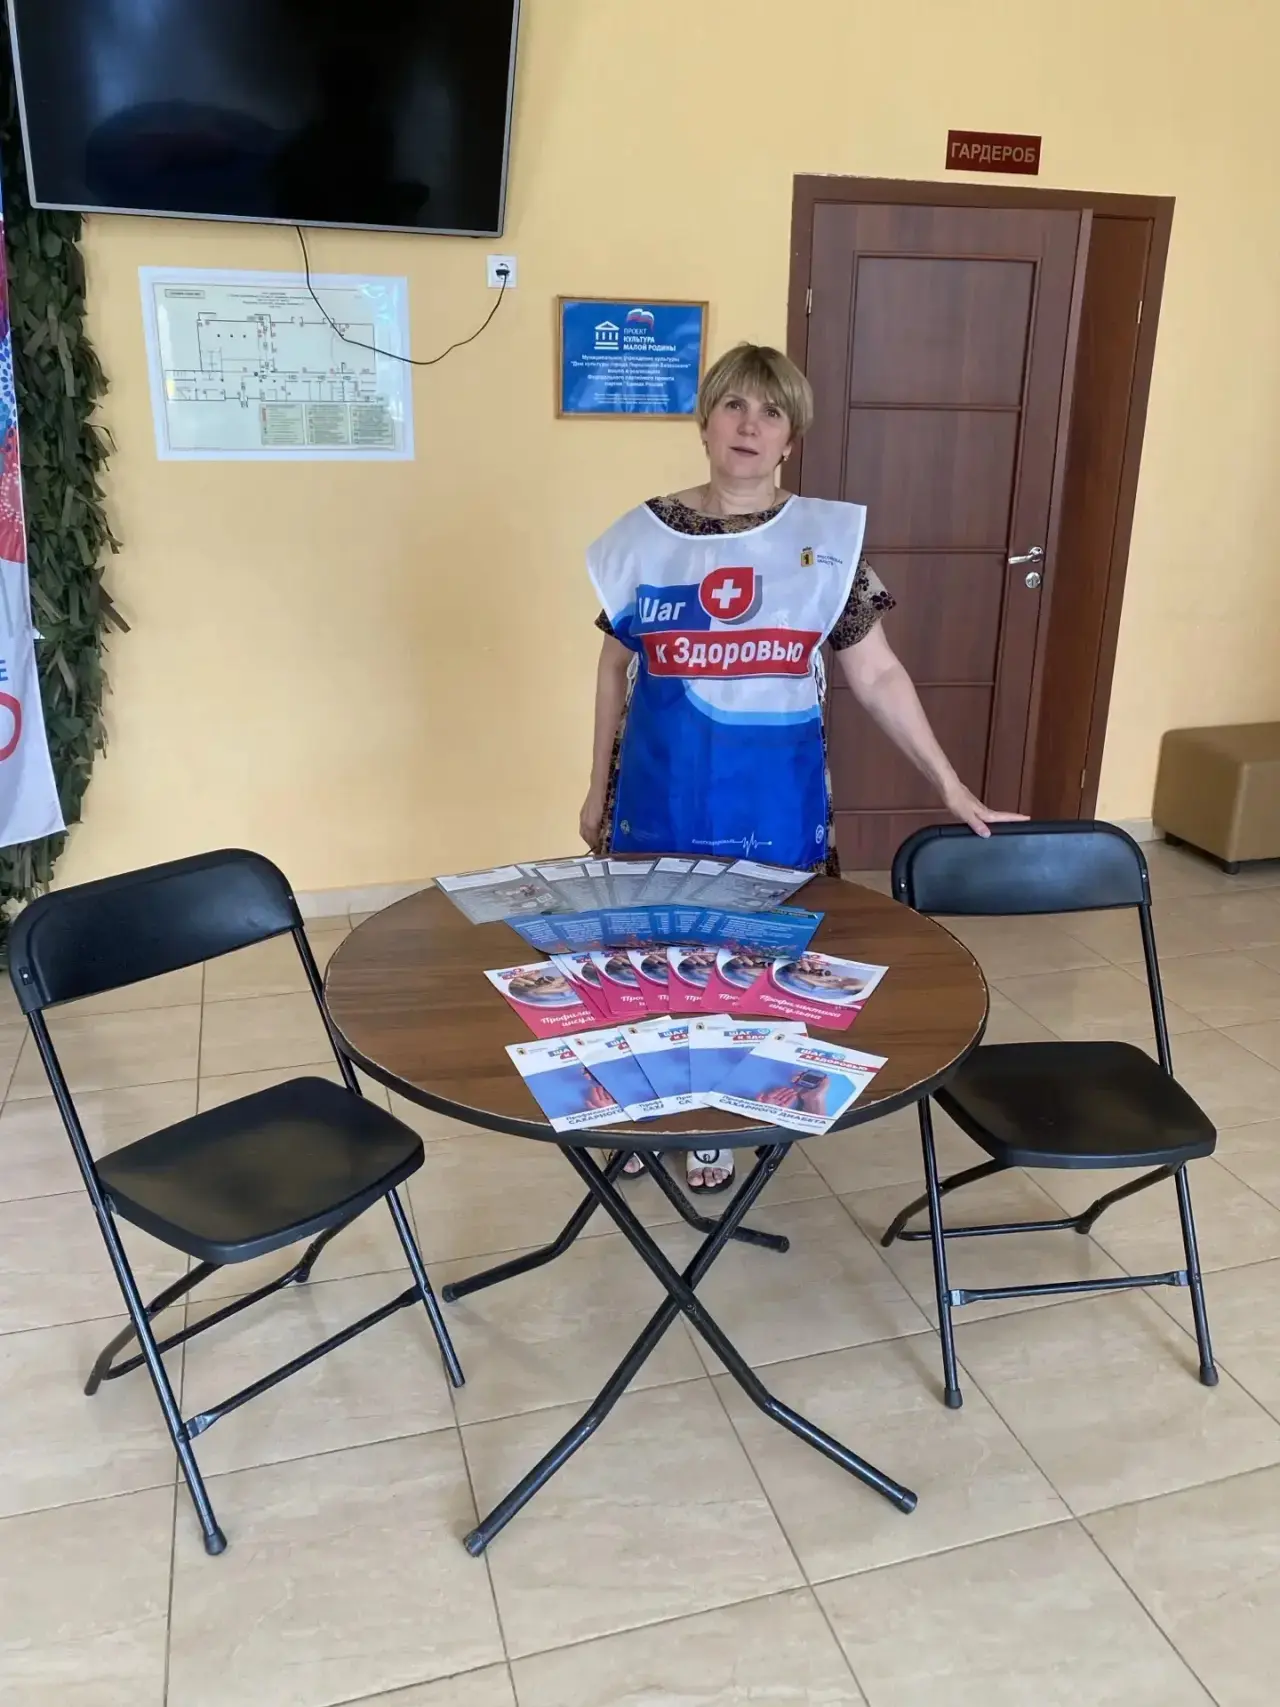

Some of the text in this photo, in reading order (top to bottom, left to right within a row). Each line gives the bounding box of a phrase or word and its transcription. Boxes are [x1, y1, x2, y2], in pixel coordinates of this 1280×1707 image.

[951, 142, 1036, 164] ГАРДЕРОБ
[639, 597, 686, 624] Шаг
[673, 636, 804, 670] Здоровью
[719, 1099, 778, 1114] САХАРНОГО
[778, 1110, 827, 1125] ДИАБЕТА
